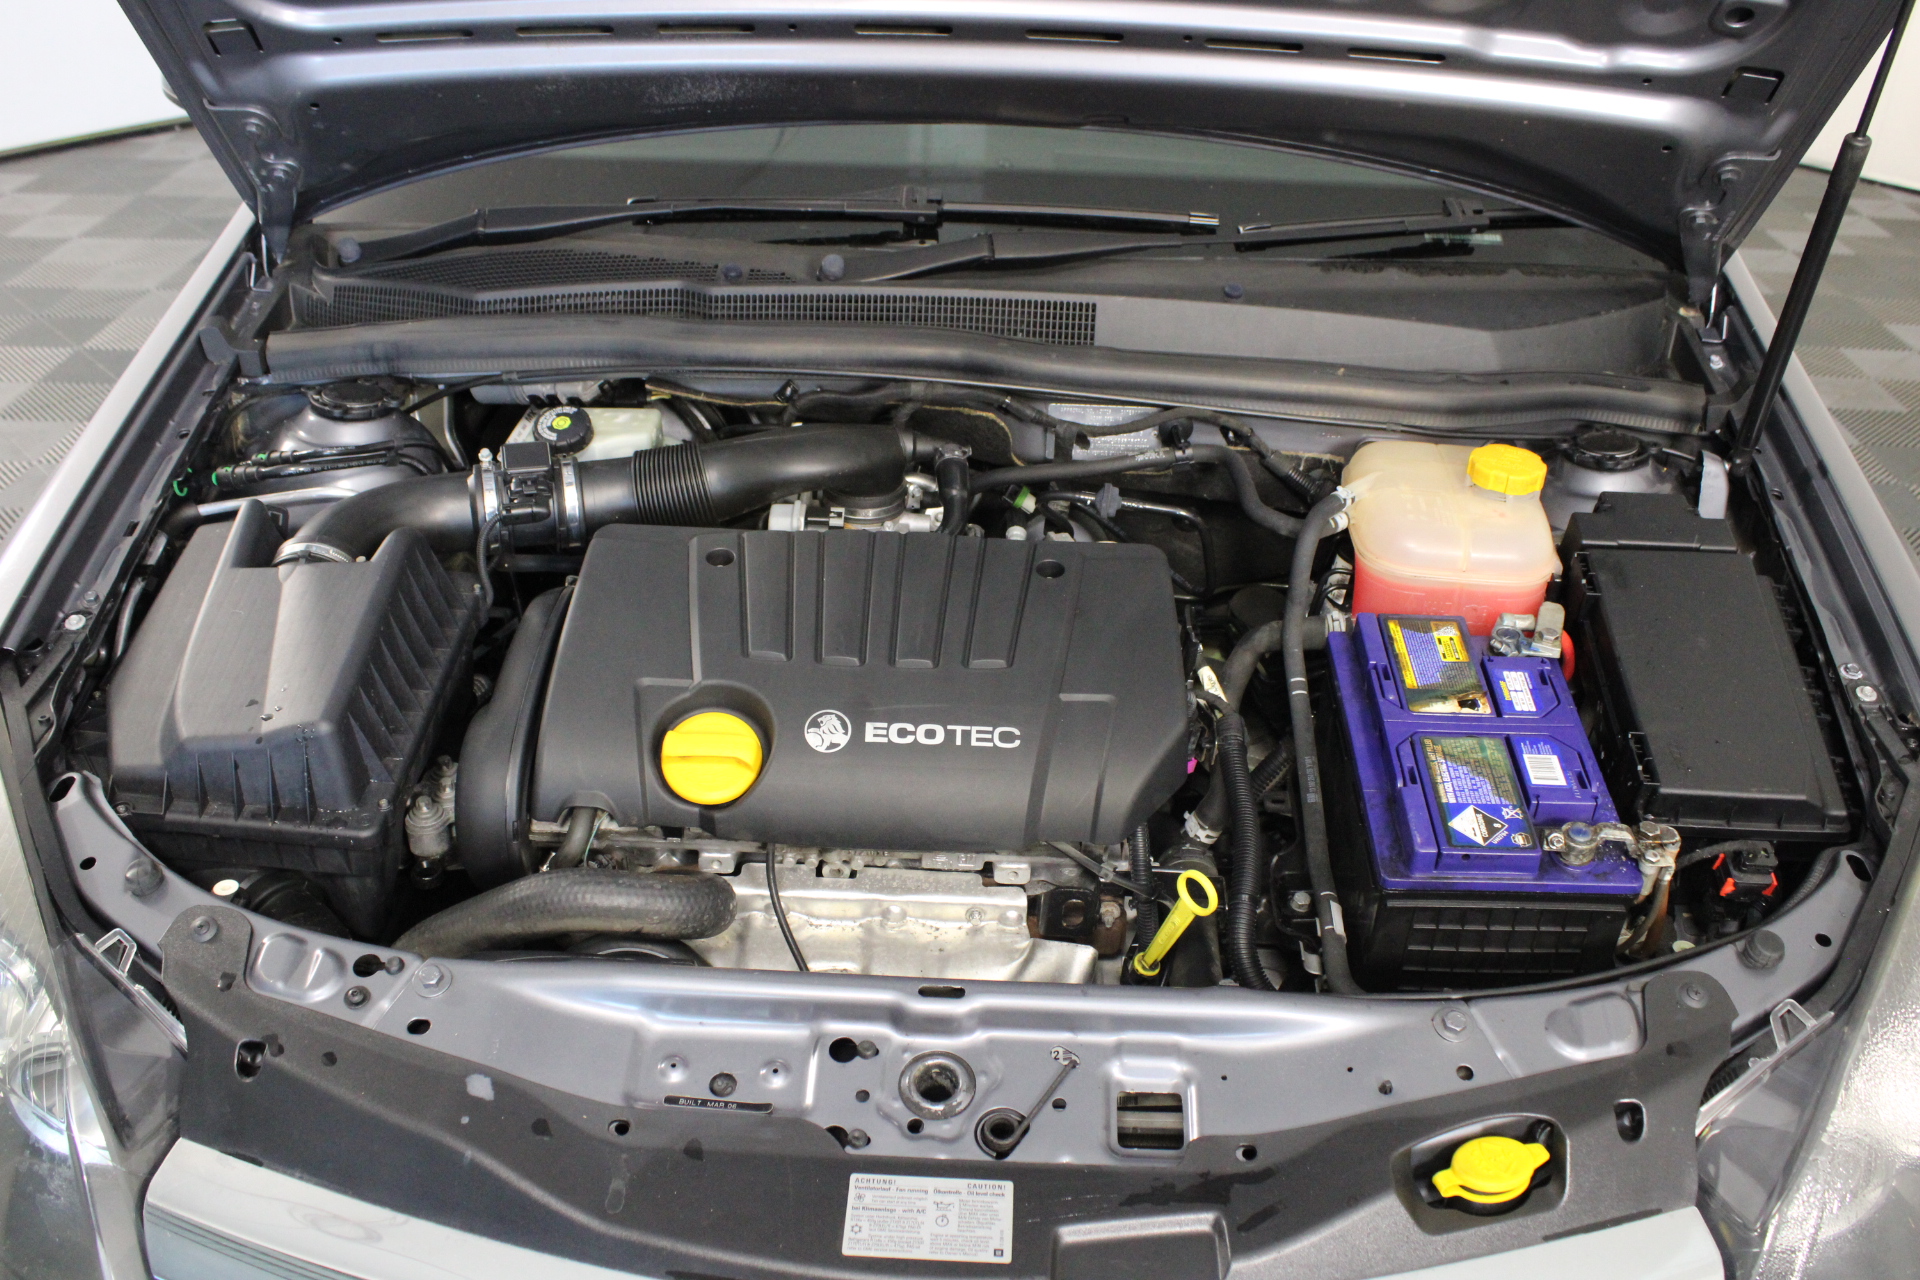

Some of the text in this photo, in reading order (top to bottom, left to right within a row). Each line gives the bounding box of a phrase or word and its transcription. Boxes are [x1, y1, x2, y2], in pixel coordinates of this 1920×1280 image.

[865, 722, 1020, 748] ECOTEC
[1476, 814, 1488, 837] CORROSIVE
[1053, 1050, 1060, 1060] 2
